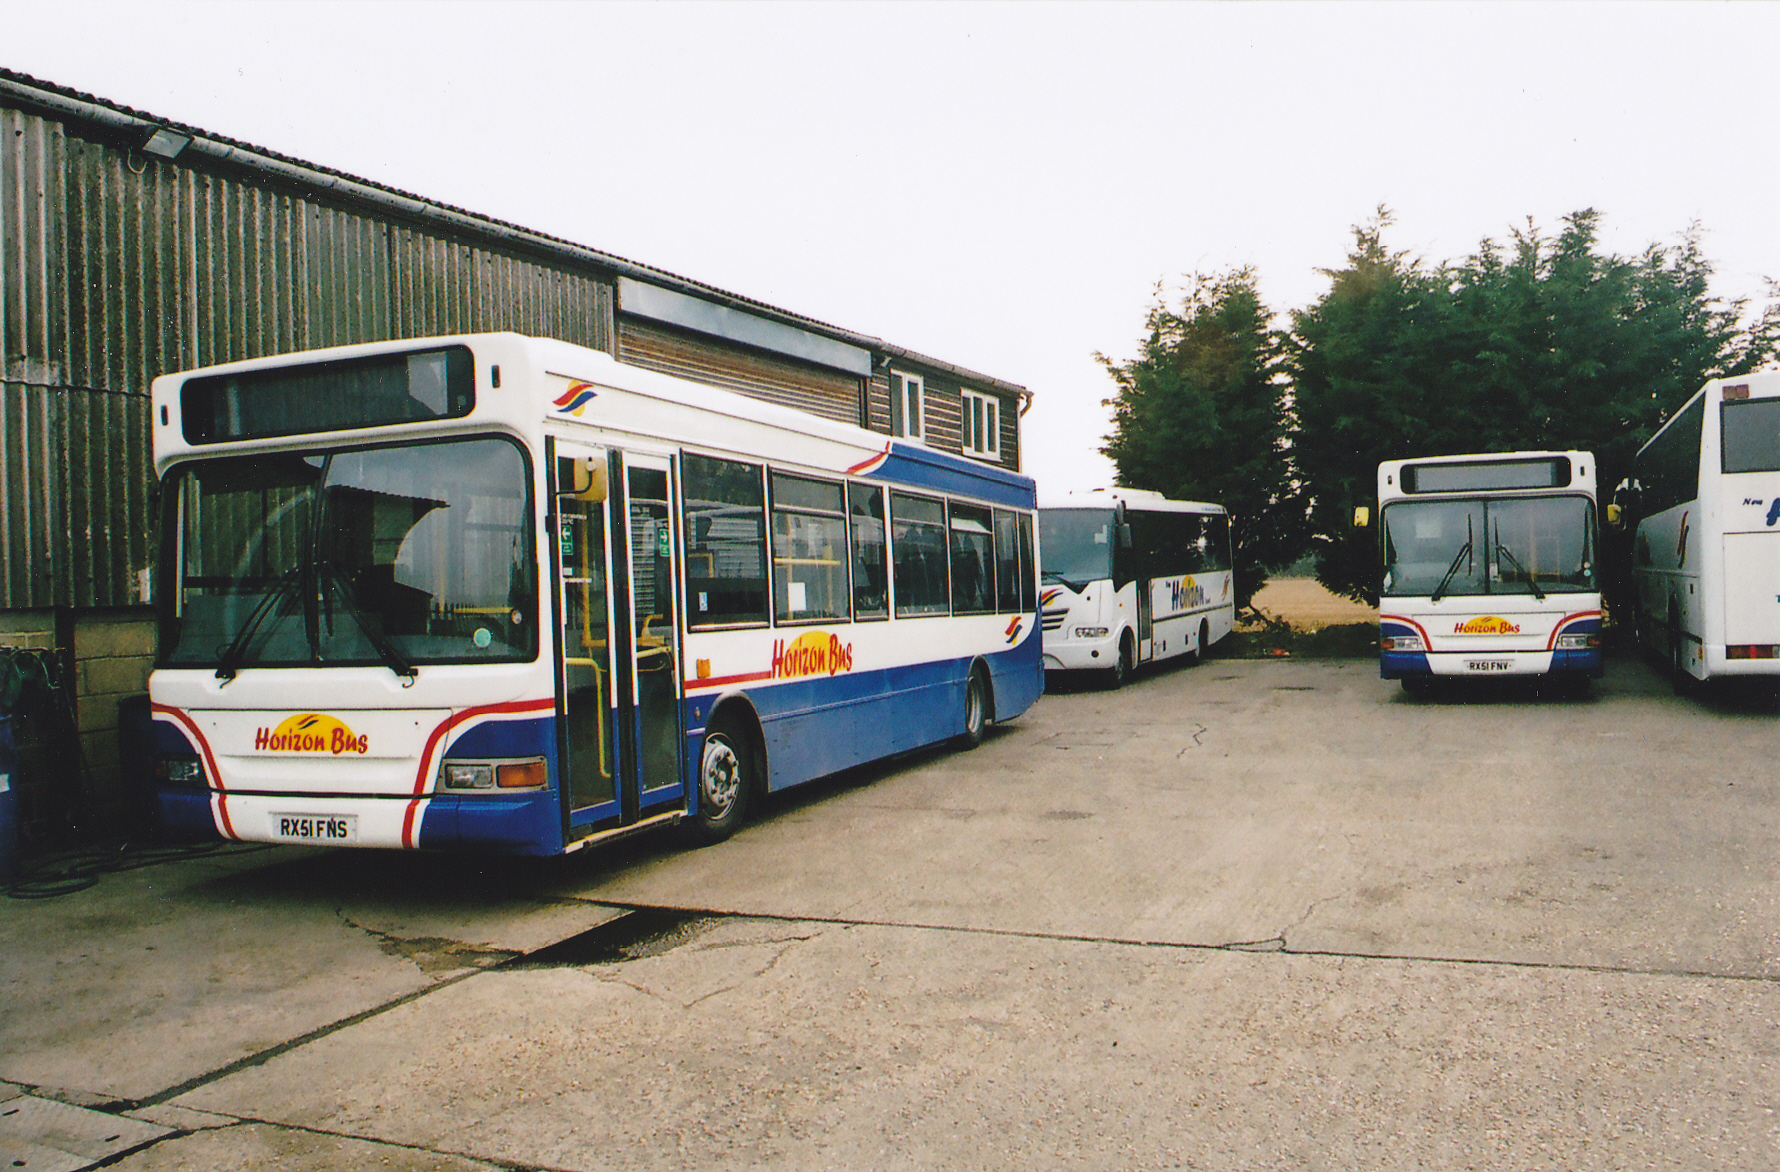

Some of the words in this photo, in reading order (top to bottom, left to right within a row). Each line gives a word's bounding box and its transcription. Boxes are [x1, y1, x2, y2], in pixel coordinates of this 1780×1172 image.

[1454, 622, 1497, 634] Horizon
[1499, 621, 1520, 635] Bus
[771, 638, 826, 679] Horizon
[828, 633, 853, 677] Bus
[1469, 661, 1490, 671] RX51
[1490, 661, 1508, 671] FNV
[255, 727, 325, 752] Horizon
[331, 727, 369, 755] Bus
[280, 818, 314, 838] RX51
[316, 818, 348, 839] FNS
